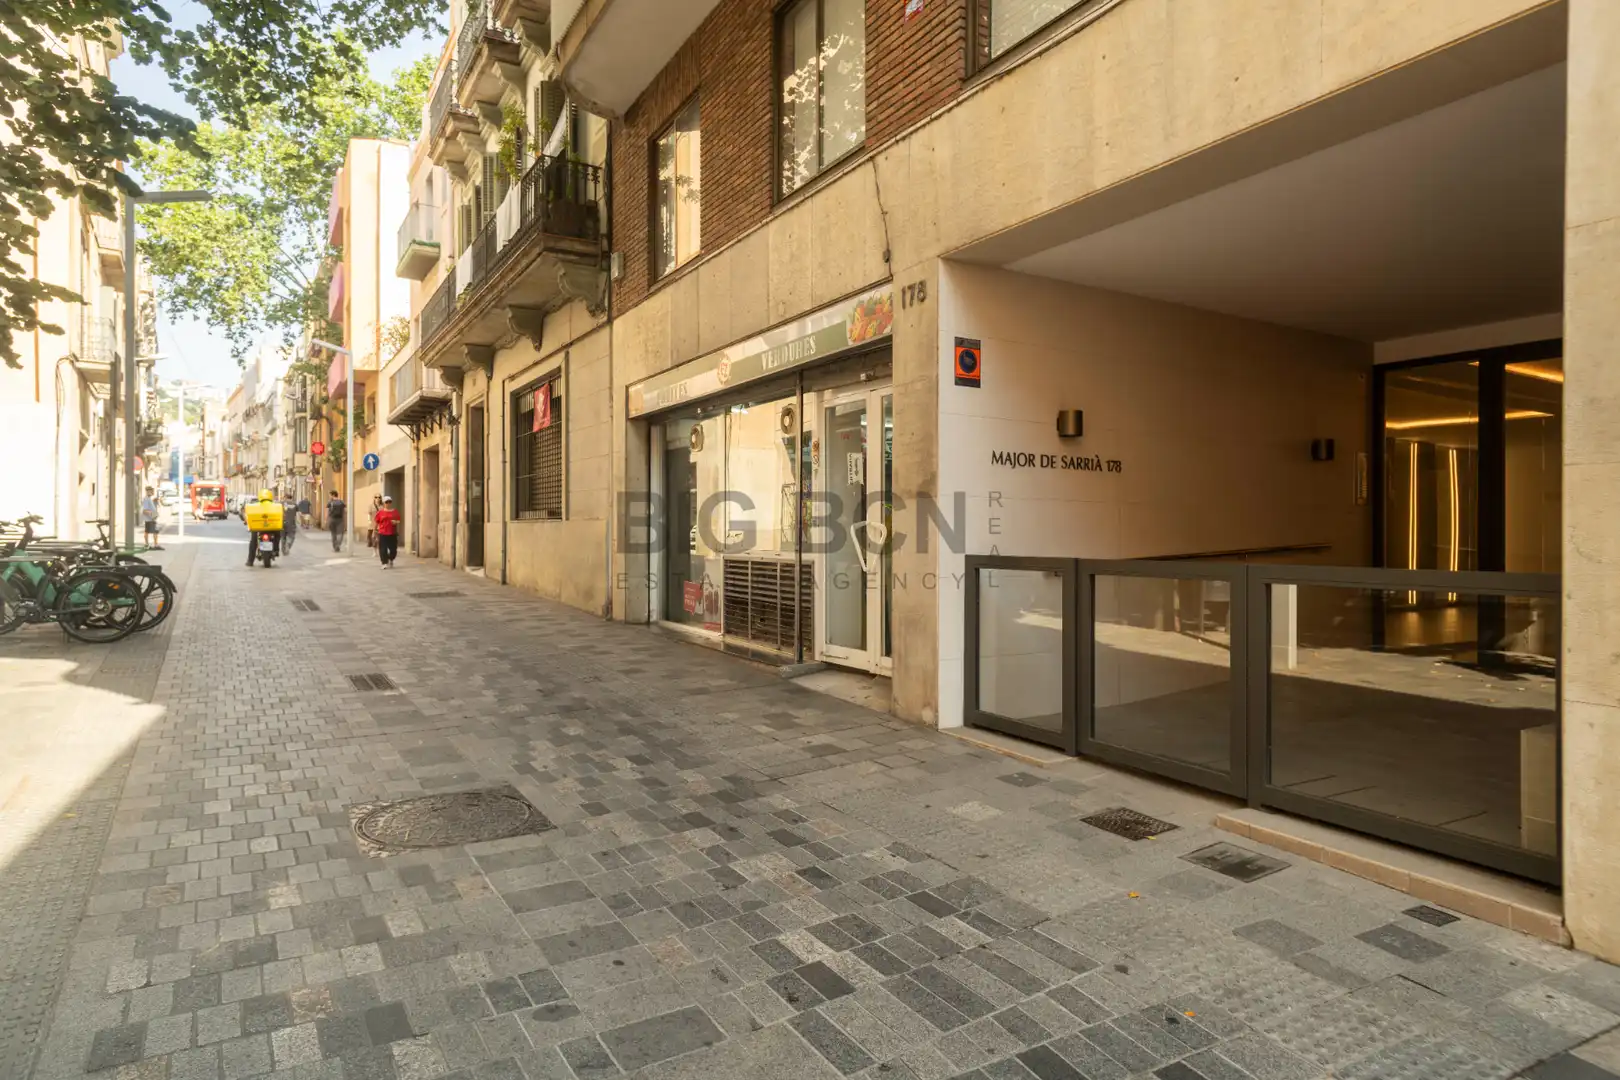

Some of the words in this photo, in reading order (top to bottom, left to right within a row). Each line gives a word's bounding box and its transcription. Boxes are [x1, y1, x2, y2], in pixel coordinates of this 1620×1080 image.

[901, 280, 927, 310] 178
[991, 450, 1036, 469] MAJOR
[1040, 454, 1057, 469] DE
[1061, 454, 1103, 472] SARRIÀ
[1106, 460, 1122, 473] 178
